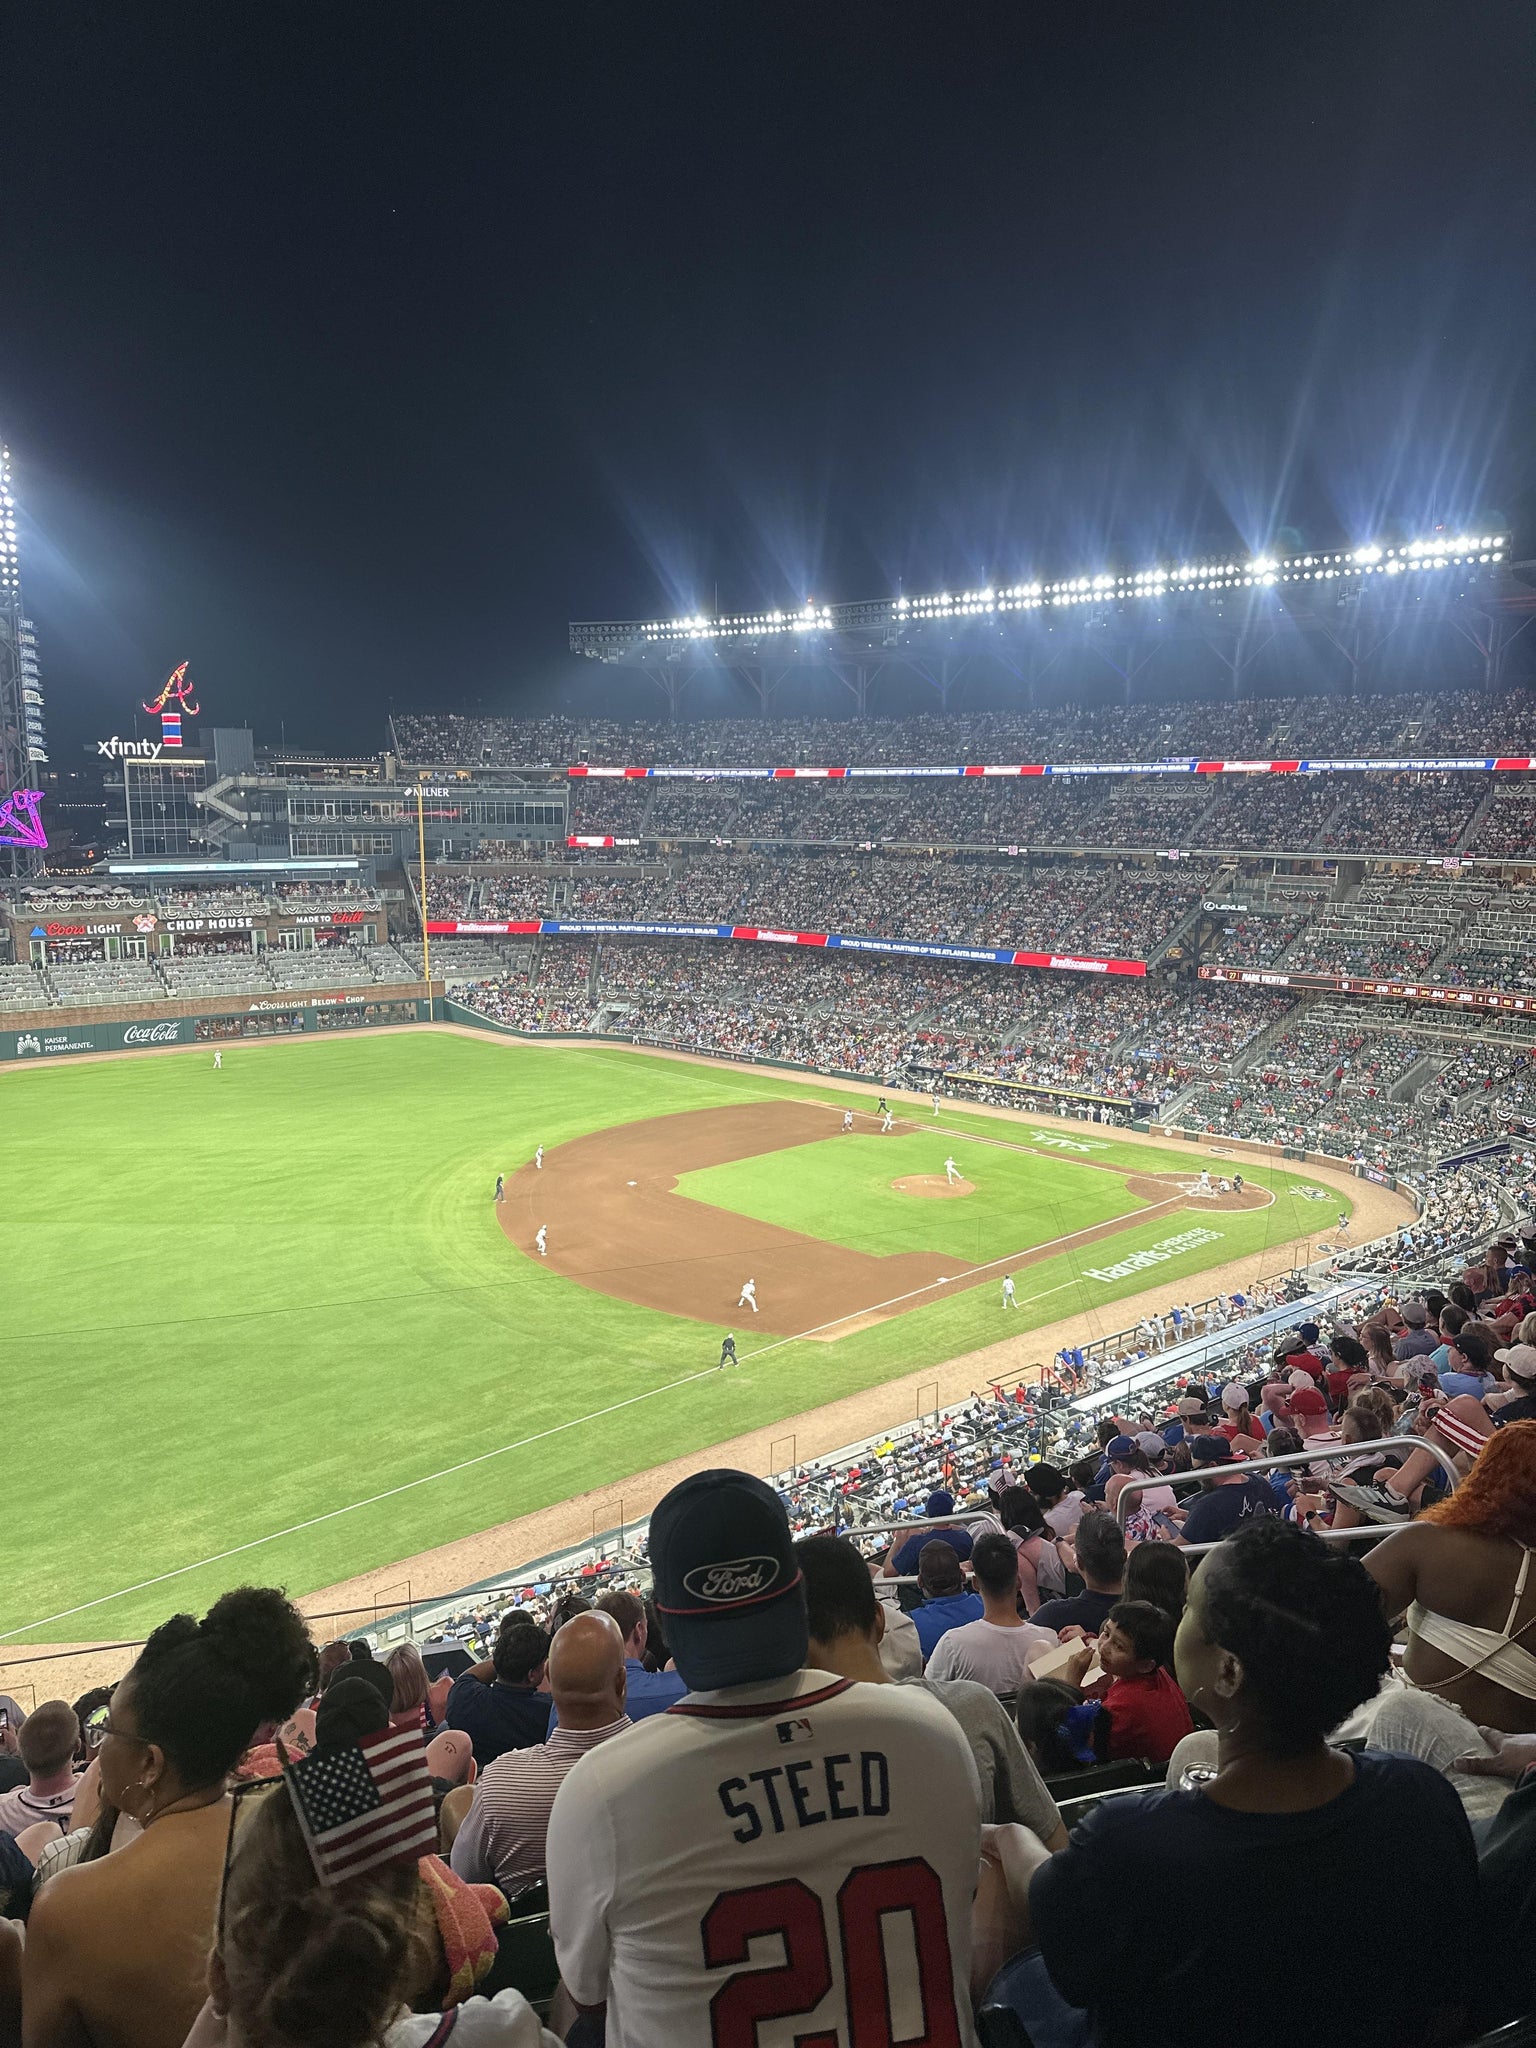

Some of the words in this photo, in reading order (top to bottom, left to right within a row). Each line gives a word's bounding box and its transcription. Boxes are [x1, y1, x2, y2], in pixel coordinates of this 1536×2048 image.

[97, 736, 163, 760] xfinity
[1443, 857, 1460, 869] 25
[167, 919, 204, 931] CHOP
[208, 918, 254, 930] HOUSE
[296, 916, 320, 924] MADE
[332, 911, 365, 924] Chill
[46, 922, 86, 936] Coors
[86, 924, 122, 934] LIGHT
[892, 944, 920, 952] PARTNER
[942, 948, 970, 958] ATLANTA
[970, 951, 996, 960] BRAVES
[1242, 972, 1260, 982] MARK
[1262, 974, 1290, 984] VIENTOS
[259, 1001, 284, 1010] Coors
[284, 1000, 308, 1008] LIGHT
[311, 998, 337, 1006] BELOW
[44, 1036, 68, 1044] KAISER
[123, 1022, 182, 1044] Coca-Cola
[1152, 1226, 1210, 1250] CHEROKEE
[1167, 1230, 1225, 1254] CASINOS
[702, 1564, 763, 1596] Ford
[717, 1750, 890, 1844] STEED
[701, 1856, 962, 2048] 20
